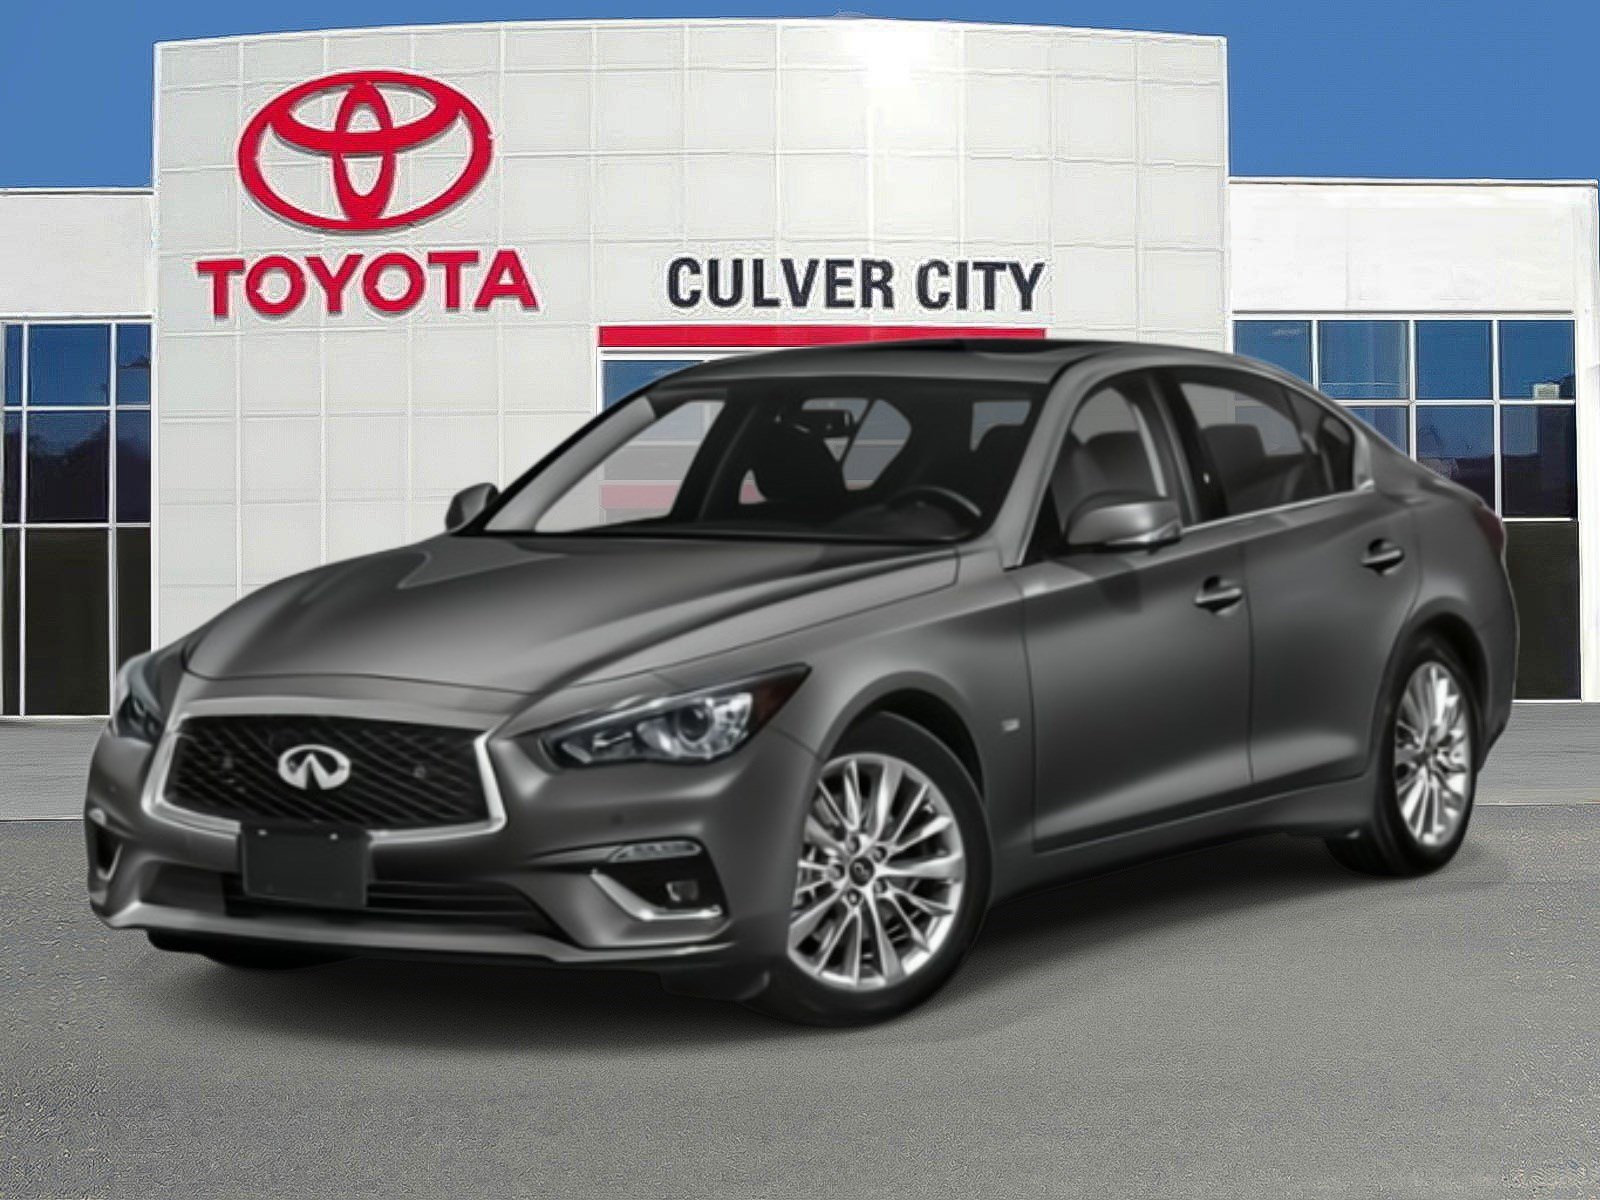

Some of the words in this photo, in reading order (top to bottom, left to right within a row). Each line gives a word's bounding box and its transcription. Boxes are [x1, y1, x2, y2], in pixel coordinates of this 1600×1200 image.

[196, 249, 538, 318] TOYOTA
[667, 257, 895, 309] CULVER
[915, 259, 1045, 311] CITY
